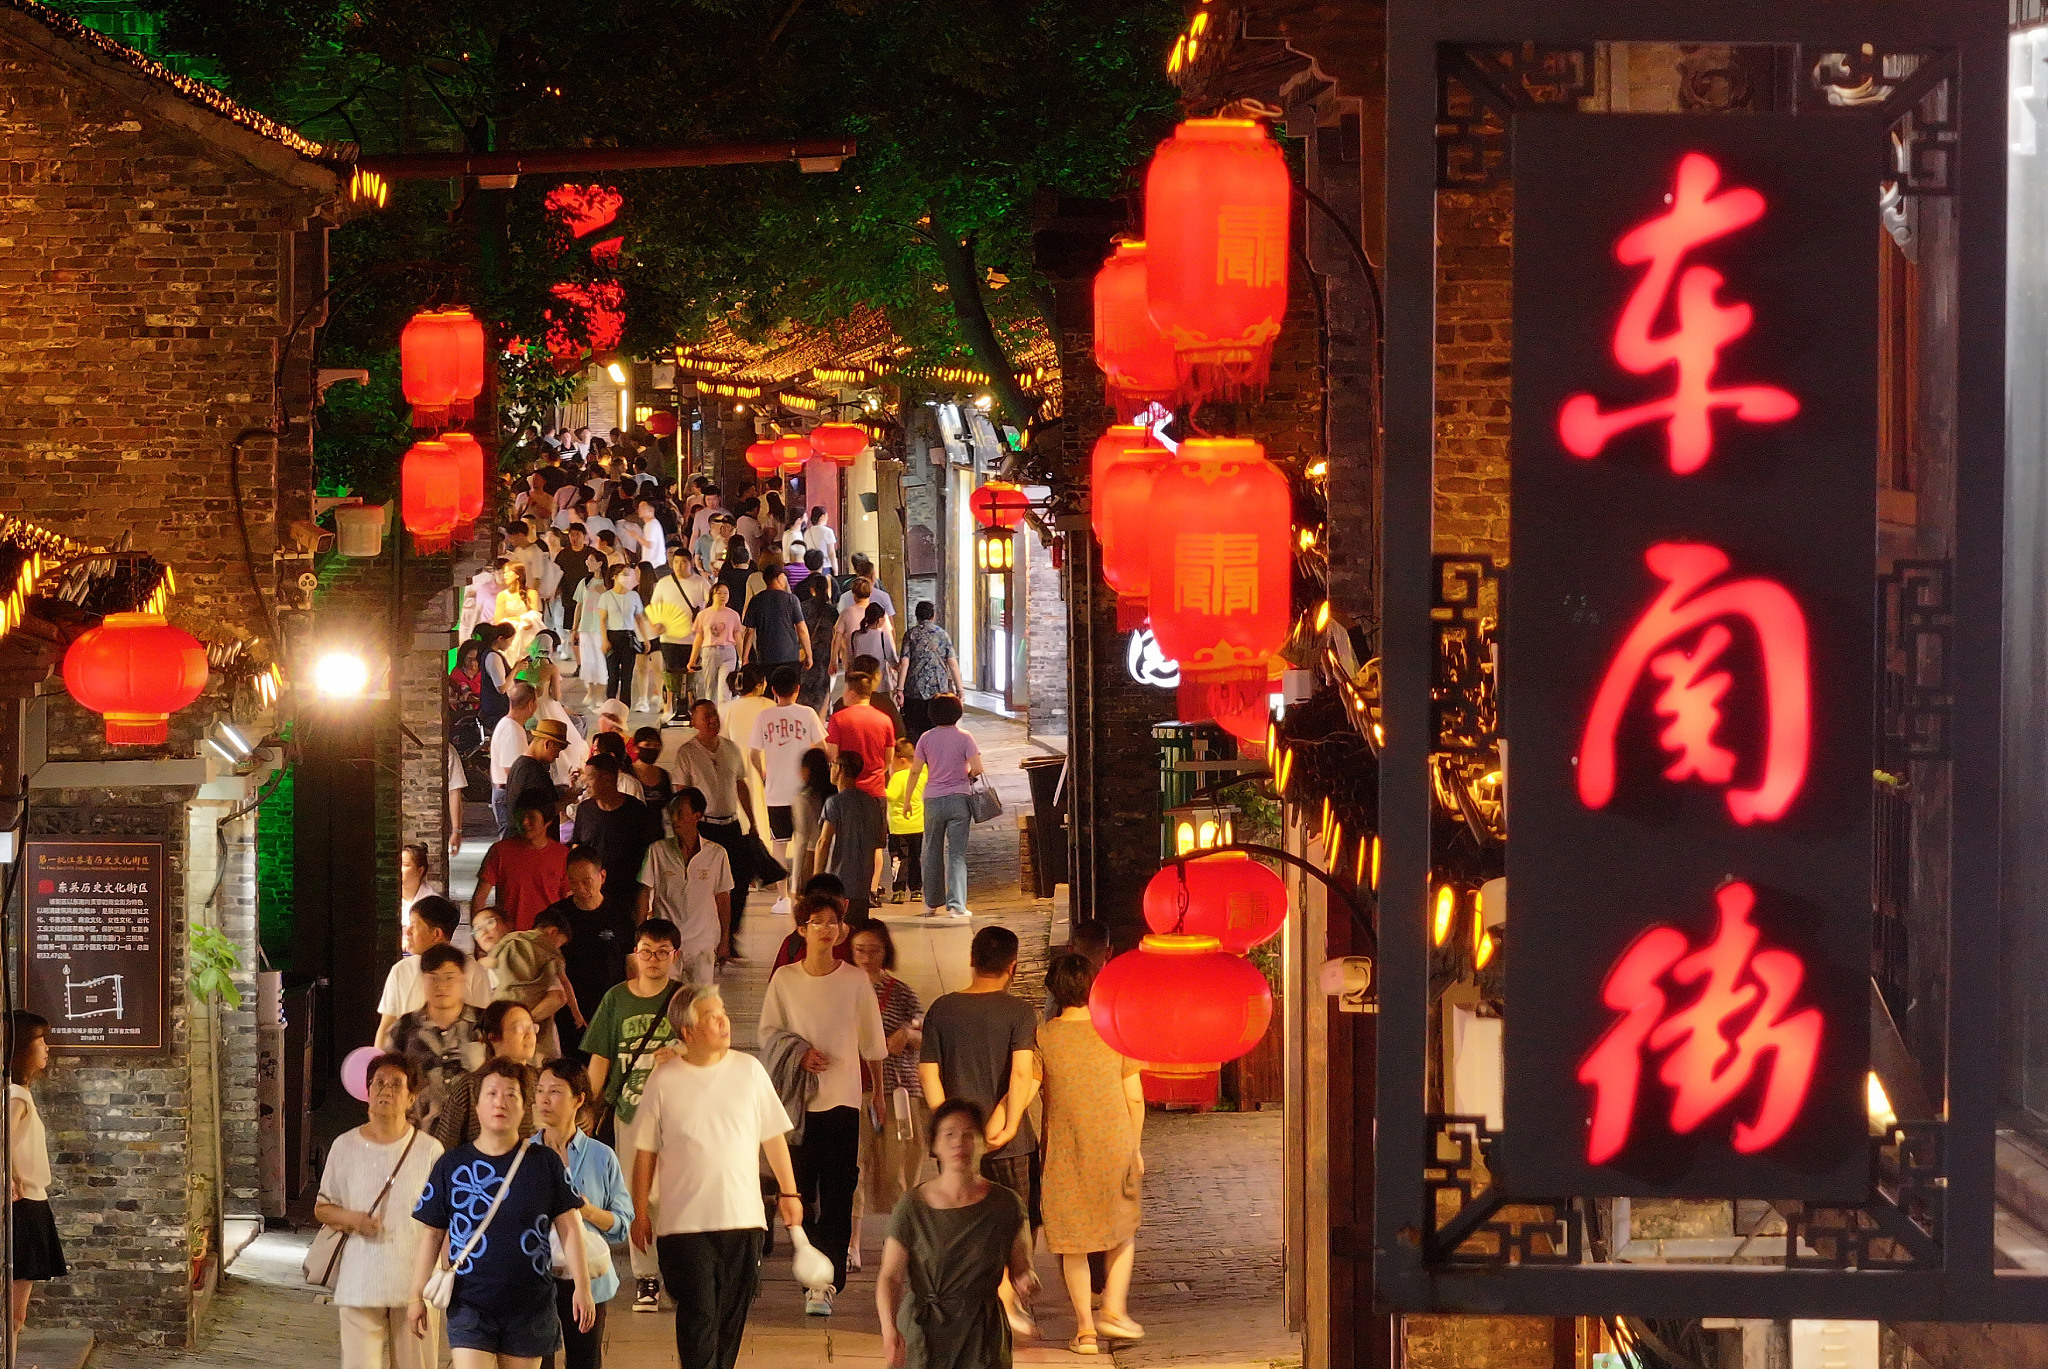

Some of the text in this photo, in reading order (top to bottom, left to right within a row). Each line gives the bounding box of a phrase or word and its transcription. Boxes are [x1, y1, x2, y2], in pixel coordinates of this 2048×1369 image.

[57, 881, 149, 895] 东关历史文化街区
